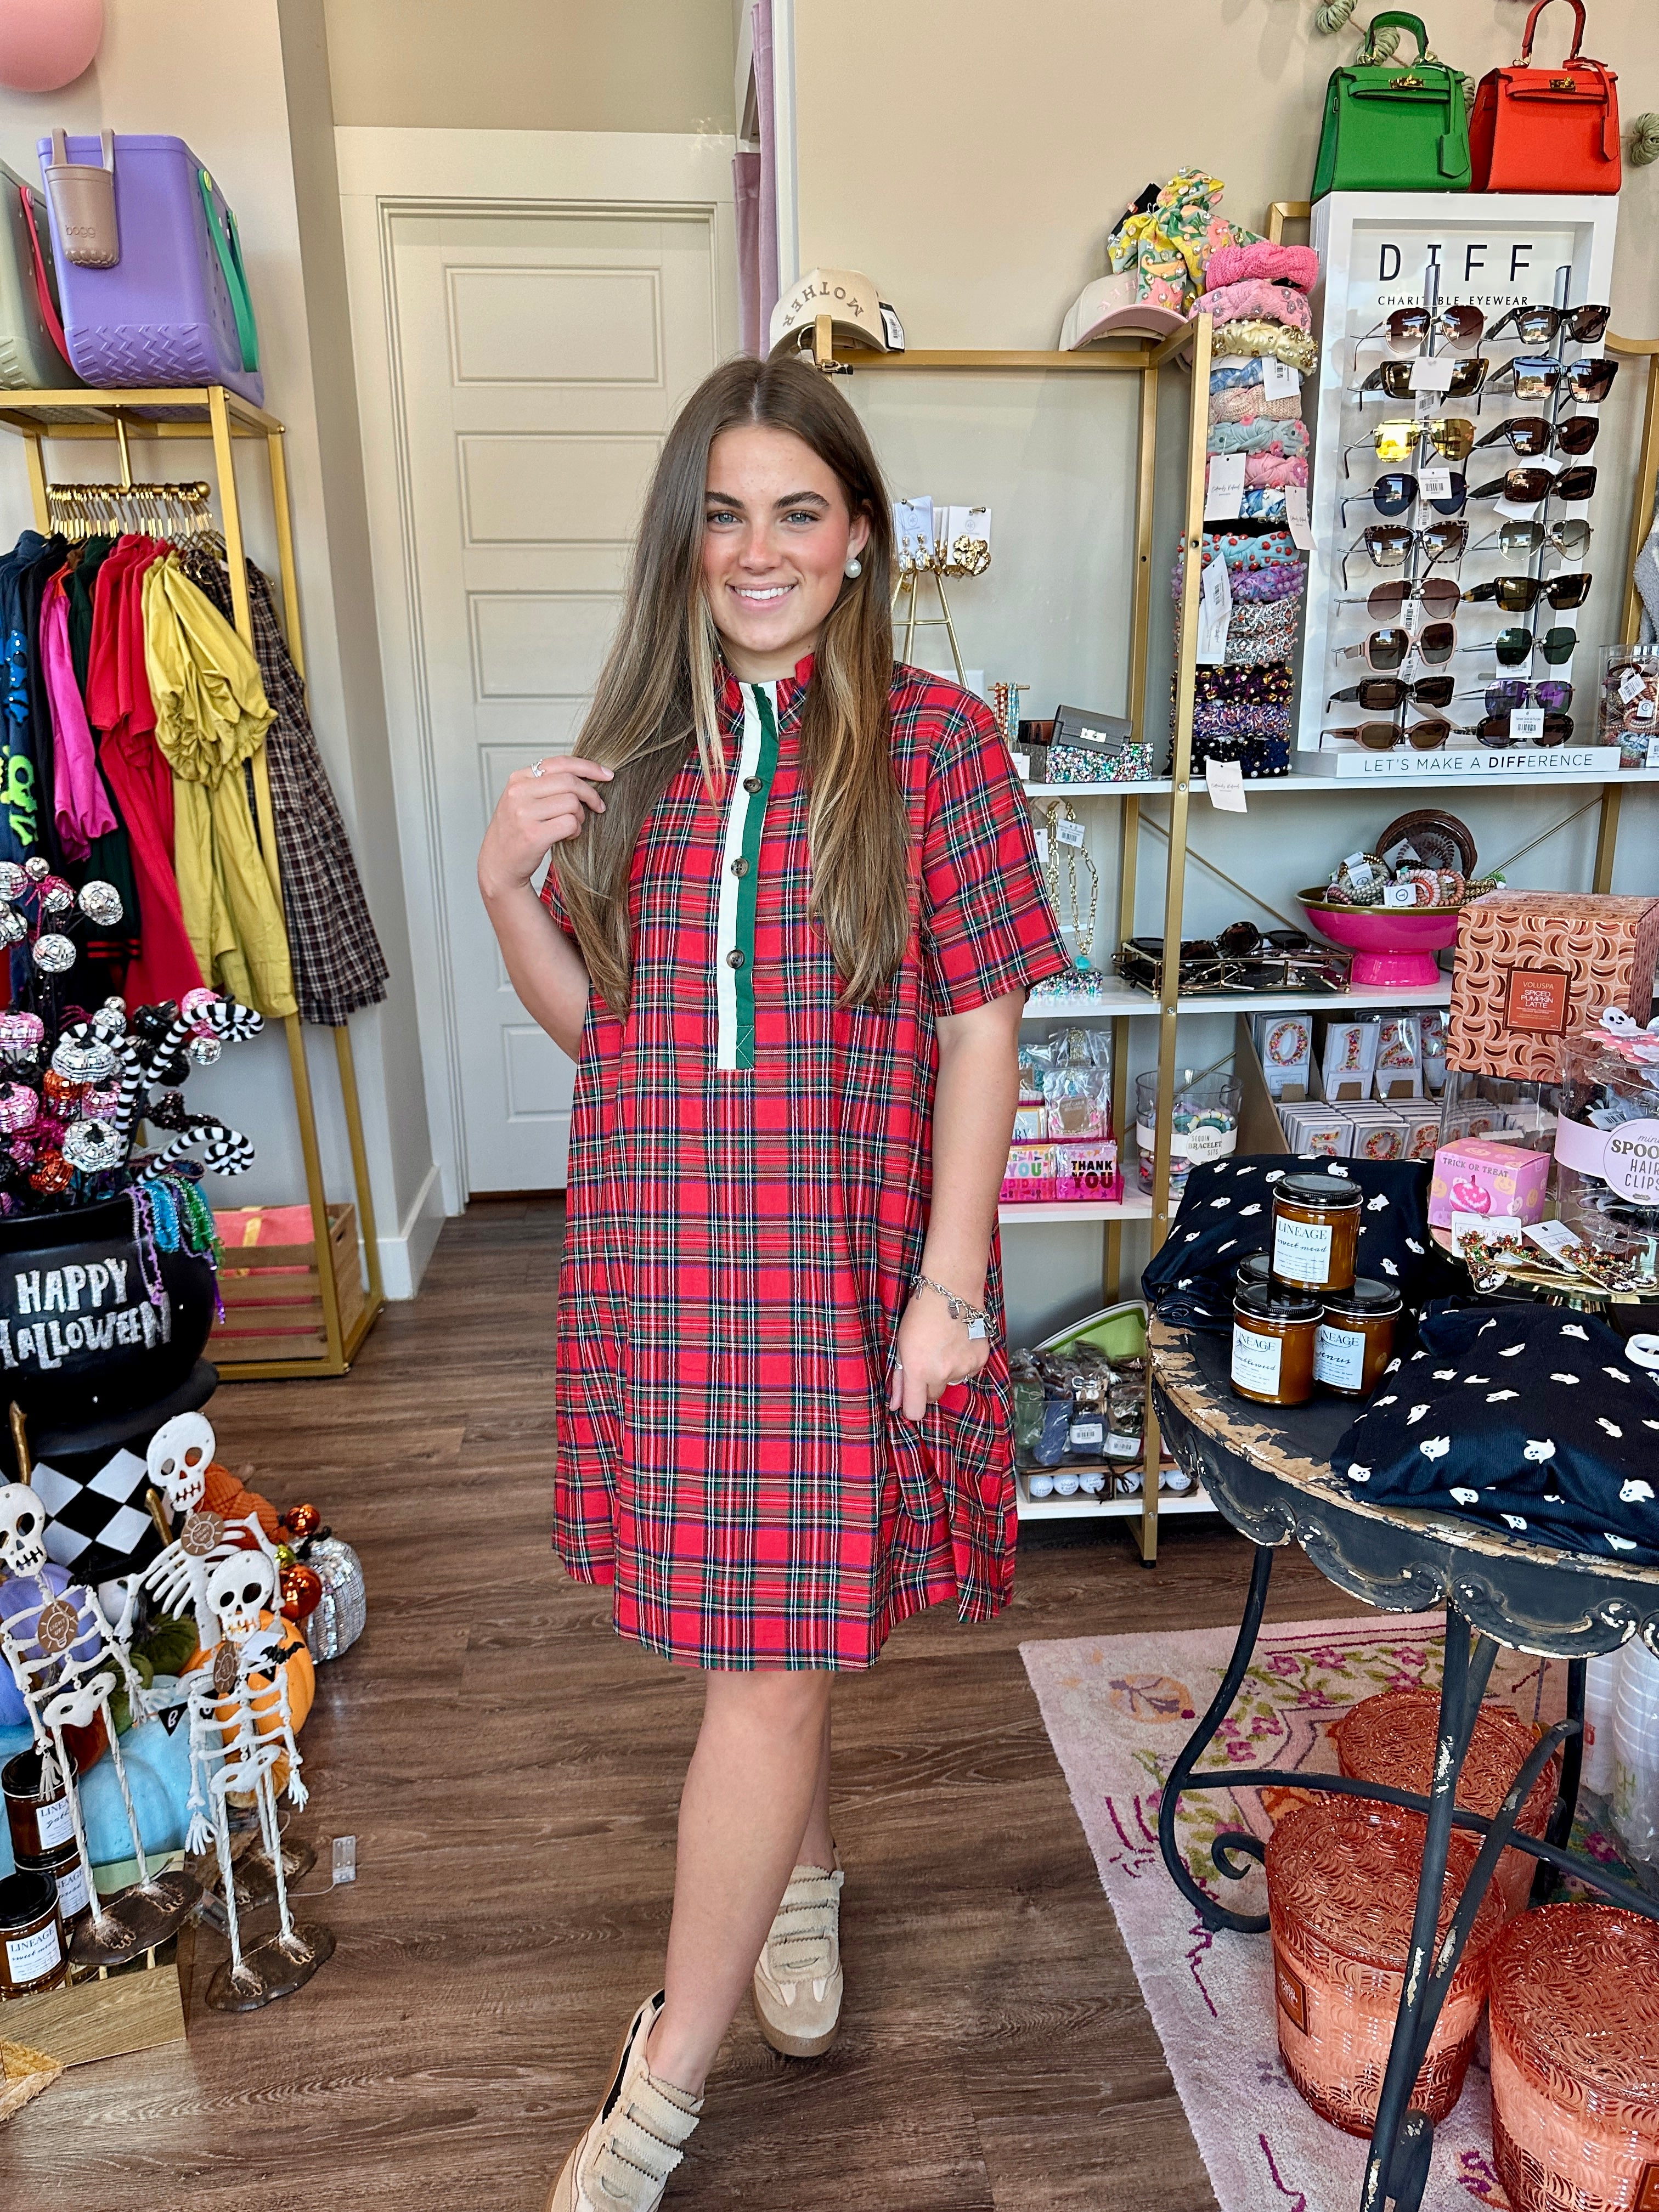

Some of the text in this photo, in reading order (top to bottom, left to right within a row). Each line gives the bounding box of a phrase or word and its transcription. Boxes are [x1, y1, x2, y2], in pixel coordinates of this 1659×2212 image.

[65, 224, 97, 238] bogg
[1379, 244, 1534, 281] DIFF
[782, 281, 865, 328] MOTHER
[1378, 296, 1528, 306] CHARIBLE EYEWEAR
[1364, 754, 1593, 771] LET'S MAKE A DIFFERENCE
[1522, 981, 1554, 989] VOLUSPA
[1520, 995, 1554, 1003] PUMPKIN
[1188, 1141, 1222, 1150] BRACELET
[1071, 1160, 1113, 1170] THANK
[1443, 1157, 1509, 1178] TRICK OR TREAT
[1071, 1171, 1113, 1189] YOU
[1278, 1221, 1327, 1240] LINEAGE
[1277, 1238, 1299, 1249] sweet
[14, 1257, 128, 1314] HAPPY
[1235, 1330, 1276, 1352] LINEAGE
[41, 1798, 69, 1817] LINEA
[10, 1925, 55, 1953] LINEAGE
